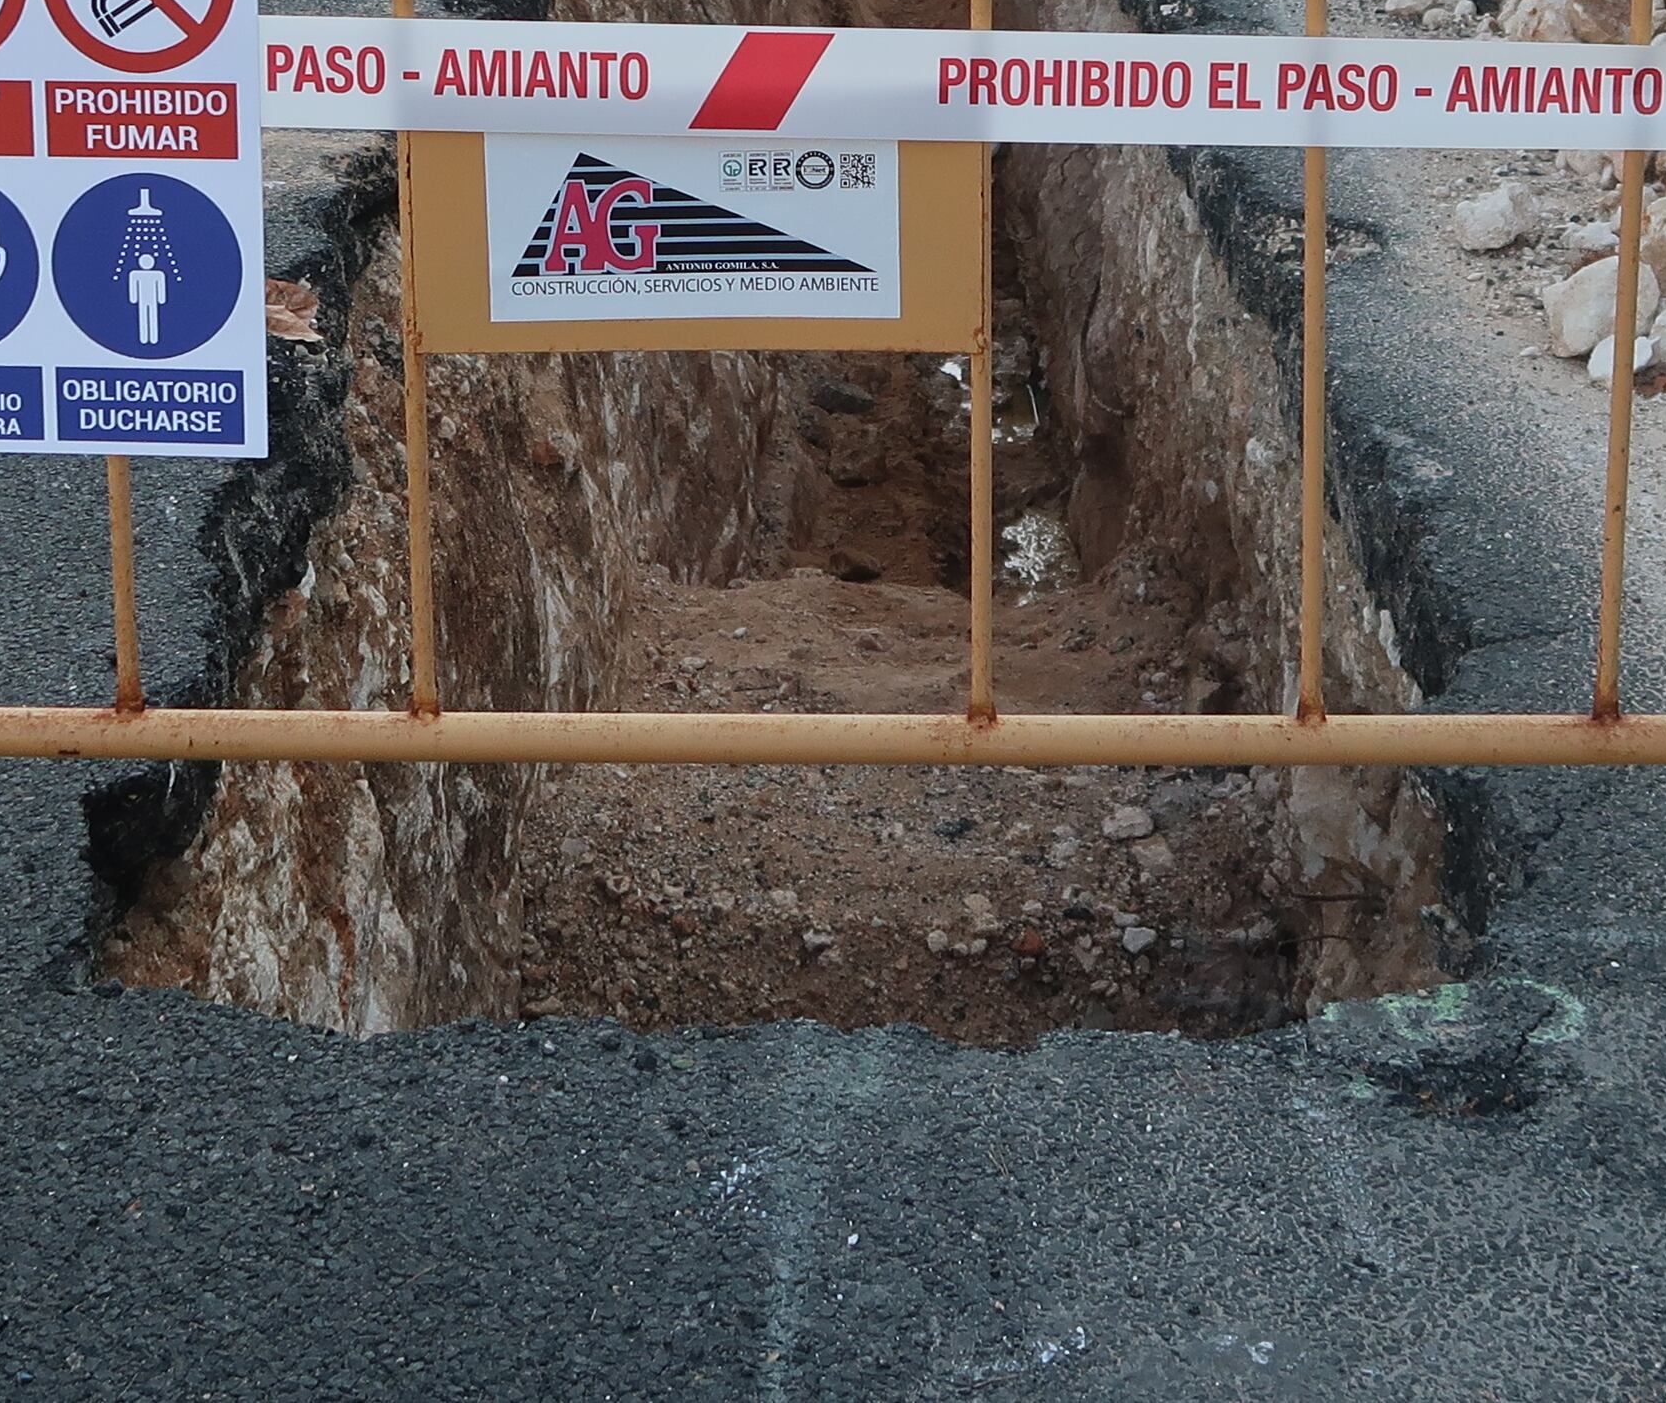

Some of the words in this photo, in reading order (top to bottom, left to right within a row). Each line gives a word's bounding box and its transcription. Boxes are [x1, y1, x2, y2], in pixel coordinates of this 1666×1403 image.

[267, 44, 387, 97] PASO
[434, 49, 650, 101] AMIANTO
[939, 57, 1193, 110] PROHIBIDO
[1209, 63, 1263, 111] EL
[1278, 64, 1400, 114] PASO
[1446, 66, 1664, 116] AMIANTO
[55, 88, 229, 118] PROHIBIDO
[86, 124, 200, 152] FUMAR
[544, 179, 658, 272] AG
[665, 261, 713, 271] ANTONIO
[511, 277, 640, 296] CONSTRUCCIÓN,
[644, 277, 722, 294] SERVICIOS
[724, 278, 735, 292] Y
[739, 277, 795, 292] MEDIO
[798, 277, 880, 292] AMBIENTE
[62, 379, 238, 405] OBLIGATORIO
[79, 408, 224, 434] DUCHARSE
